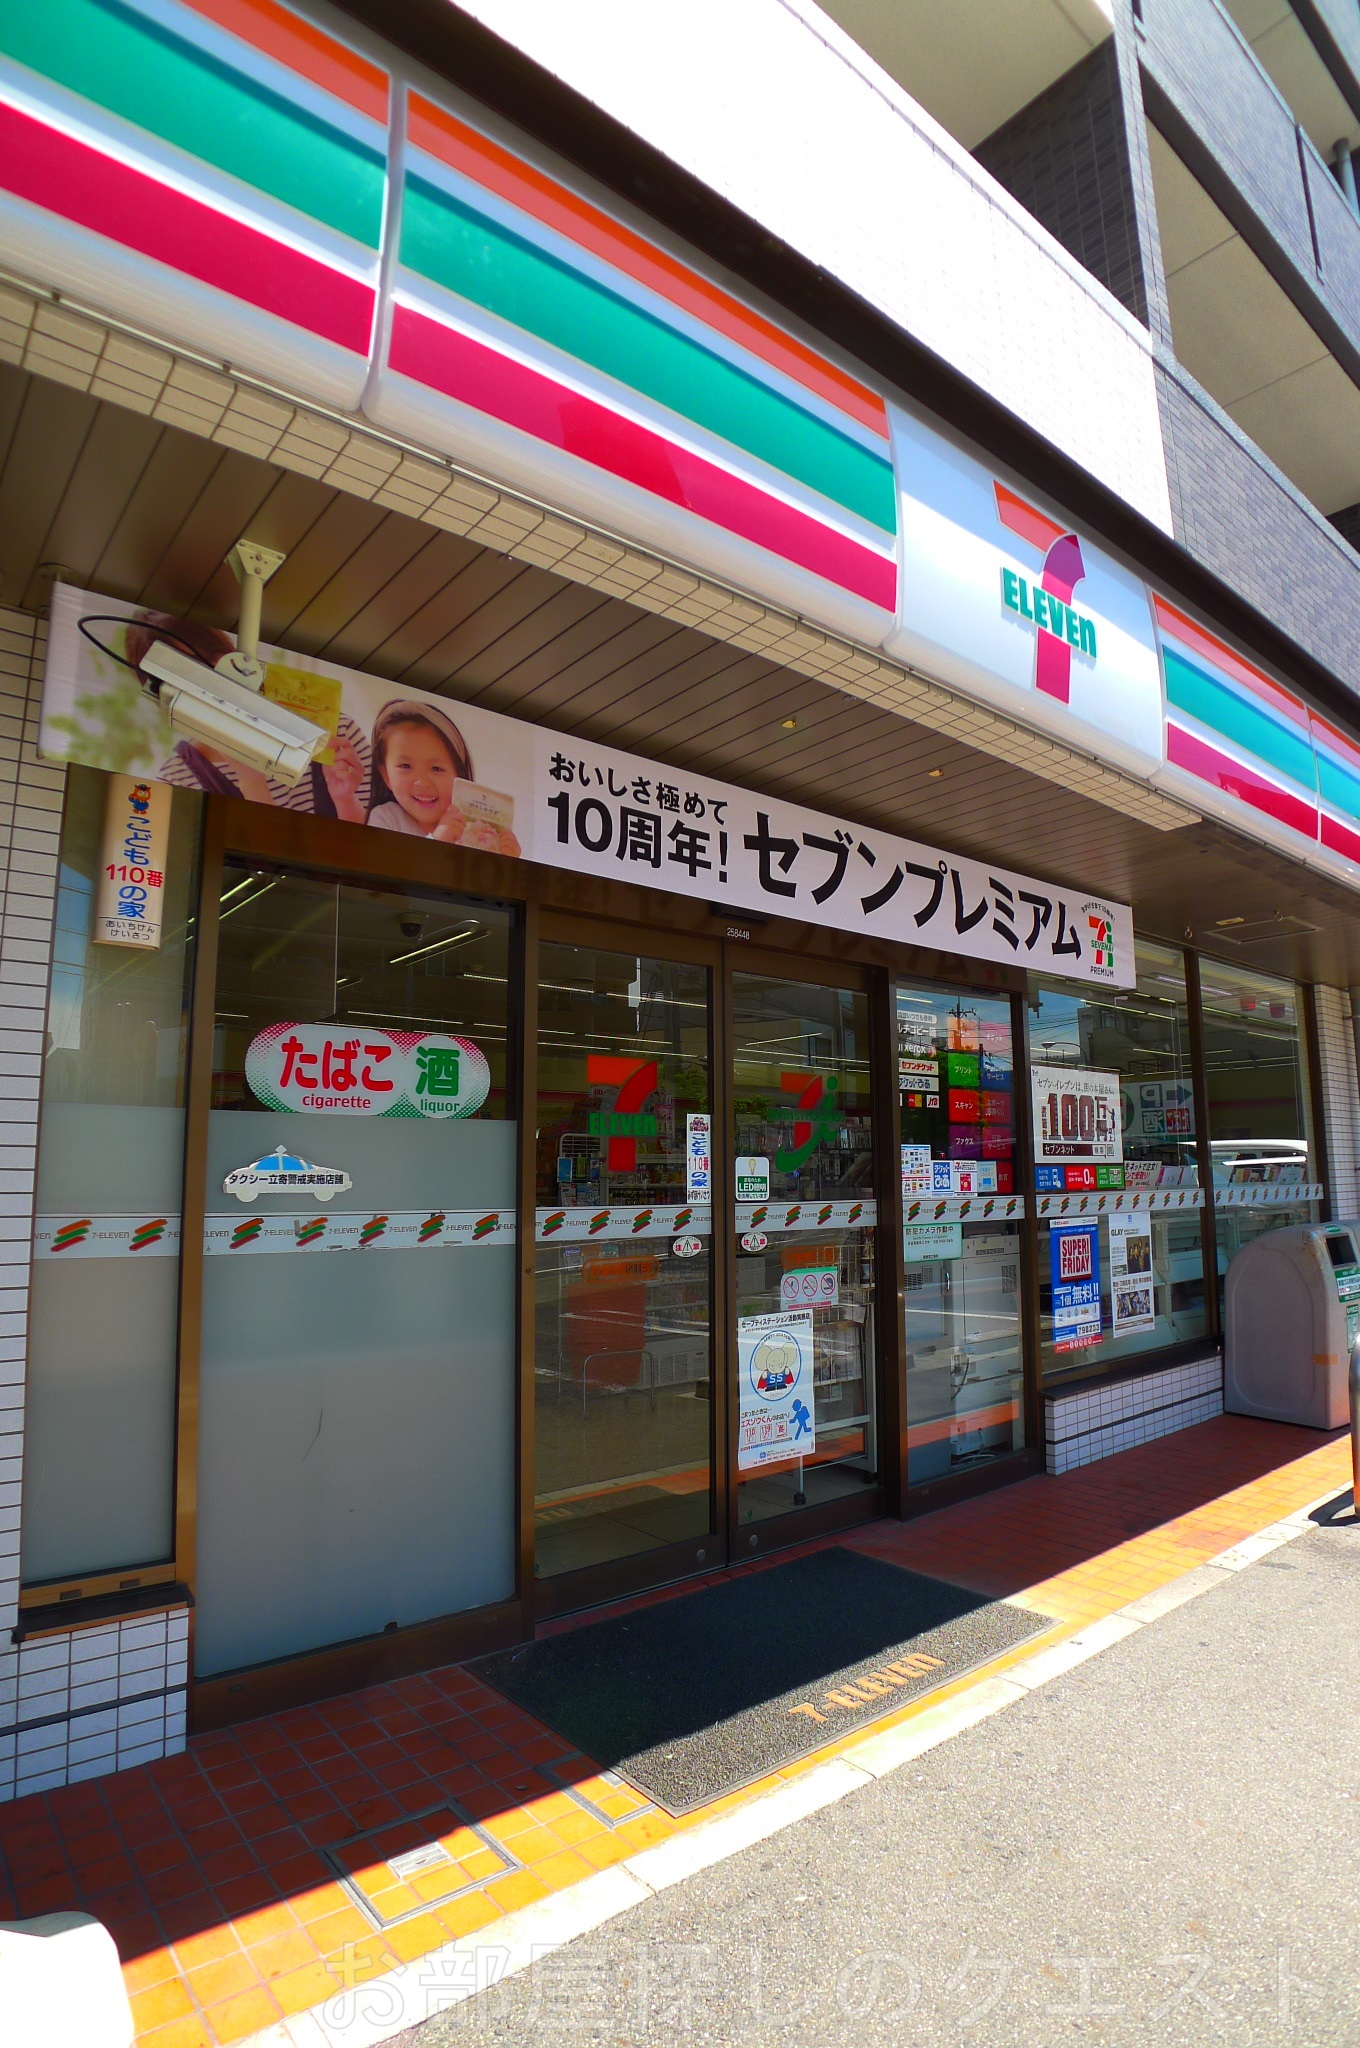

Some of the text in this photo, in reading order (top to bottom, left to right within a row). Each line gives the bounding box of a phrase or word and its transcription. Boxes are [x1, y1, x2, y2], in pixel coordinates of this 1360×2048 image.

[549, 752, 727, 826] おいしさ極めて
[547, 791, 728, 883] 10周年!
[743, 810, 1082, 961] セブンプレミアム
[105, 919, 155, 934] あいちけん
[110, 928, 151, 941] けいさつ
[1090, 965, 1115, 978] PREMIUM
[280, 1035, 394, 1092] たばこ
[901, 1060, 935, 1072] セブンチケット
[954, 1065, 972, 1075] プリント
[415, 1045, 460, 1097] 酒
[302, 1093, 371, 1110] cigarette
[419, 1098, 461, 1113] liquor
[954, 1101, 974, 1110] スキャン
[1047, 1093, 1095, 1141] 100
[955, 1137, 974, 1146] ファクス
[1045, 1145, 1075, 1155] セブンネット
[229, 1173, 344, 1185] タクシー立寄警戒実施店舗
[905, 1225, 954, 1236] 防犯カメラ作動中
[1110, 1228, 1124, 1237] GLAY
[1062, 1255, 1090, 1275] FRIDAY
[769, 1373, 784, 1384] SS
